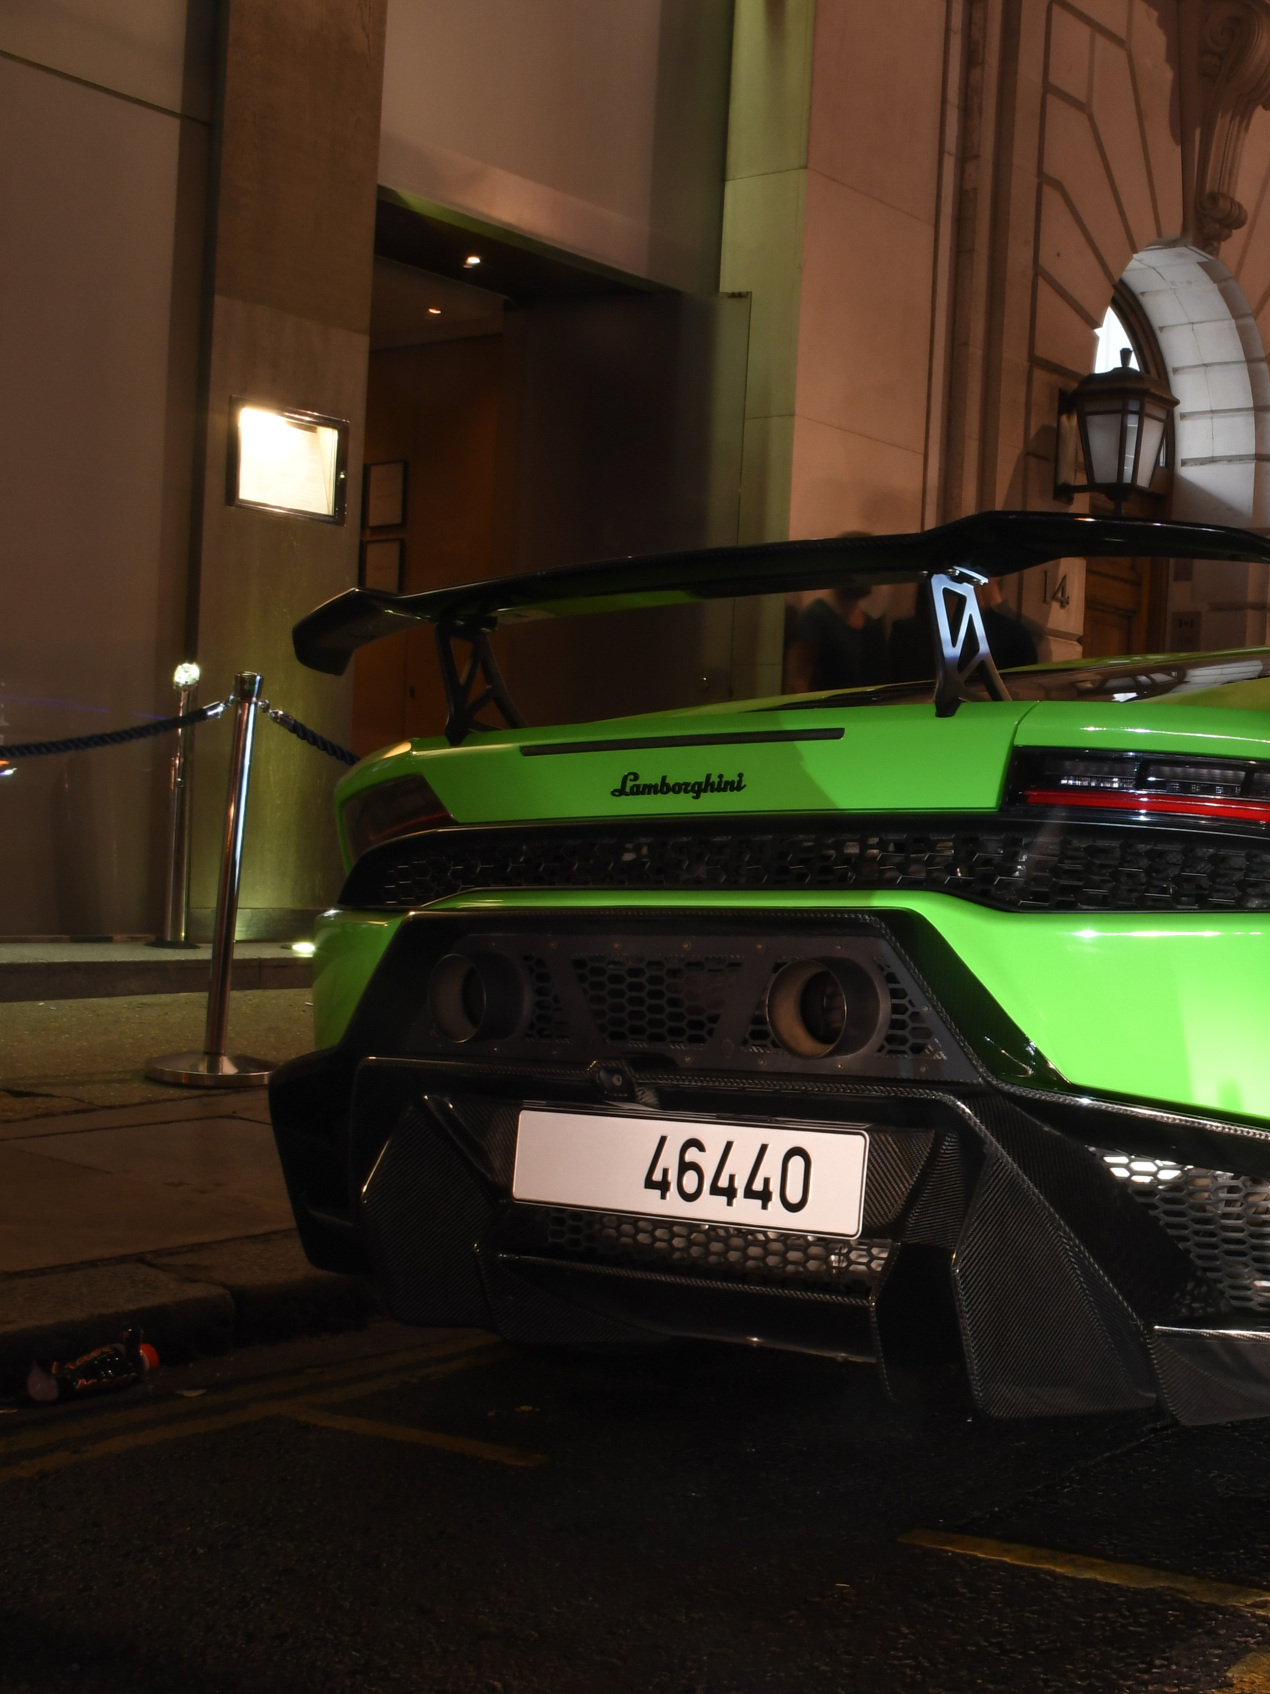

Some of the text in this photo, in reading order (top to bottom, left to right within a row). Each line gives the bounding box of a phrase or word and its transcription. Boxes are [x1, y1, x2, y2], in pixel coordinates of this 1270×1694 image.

[1043, 570, 1070, 609] 14
[610, 771, 747, 800] Lamborghini
[643, 1134, 813, 1214] 46440
